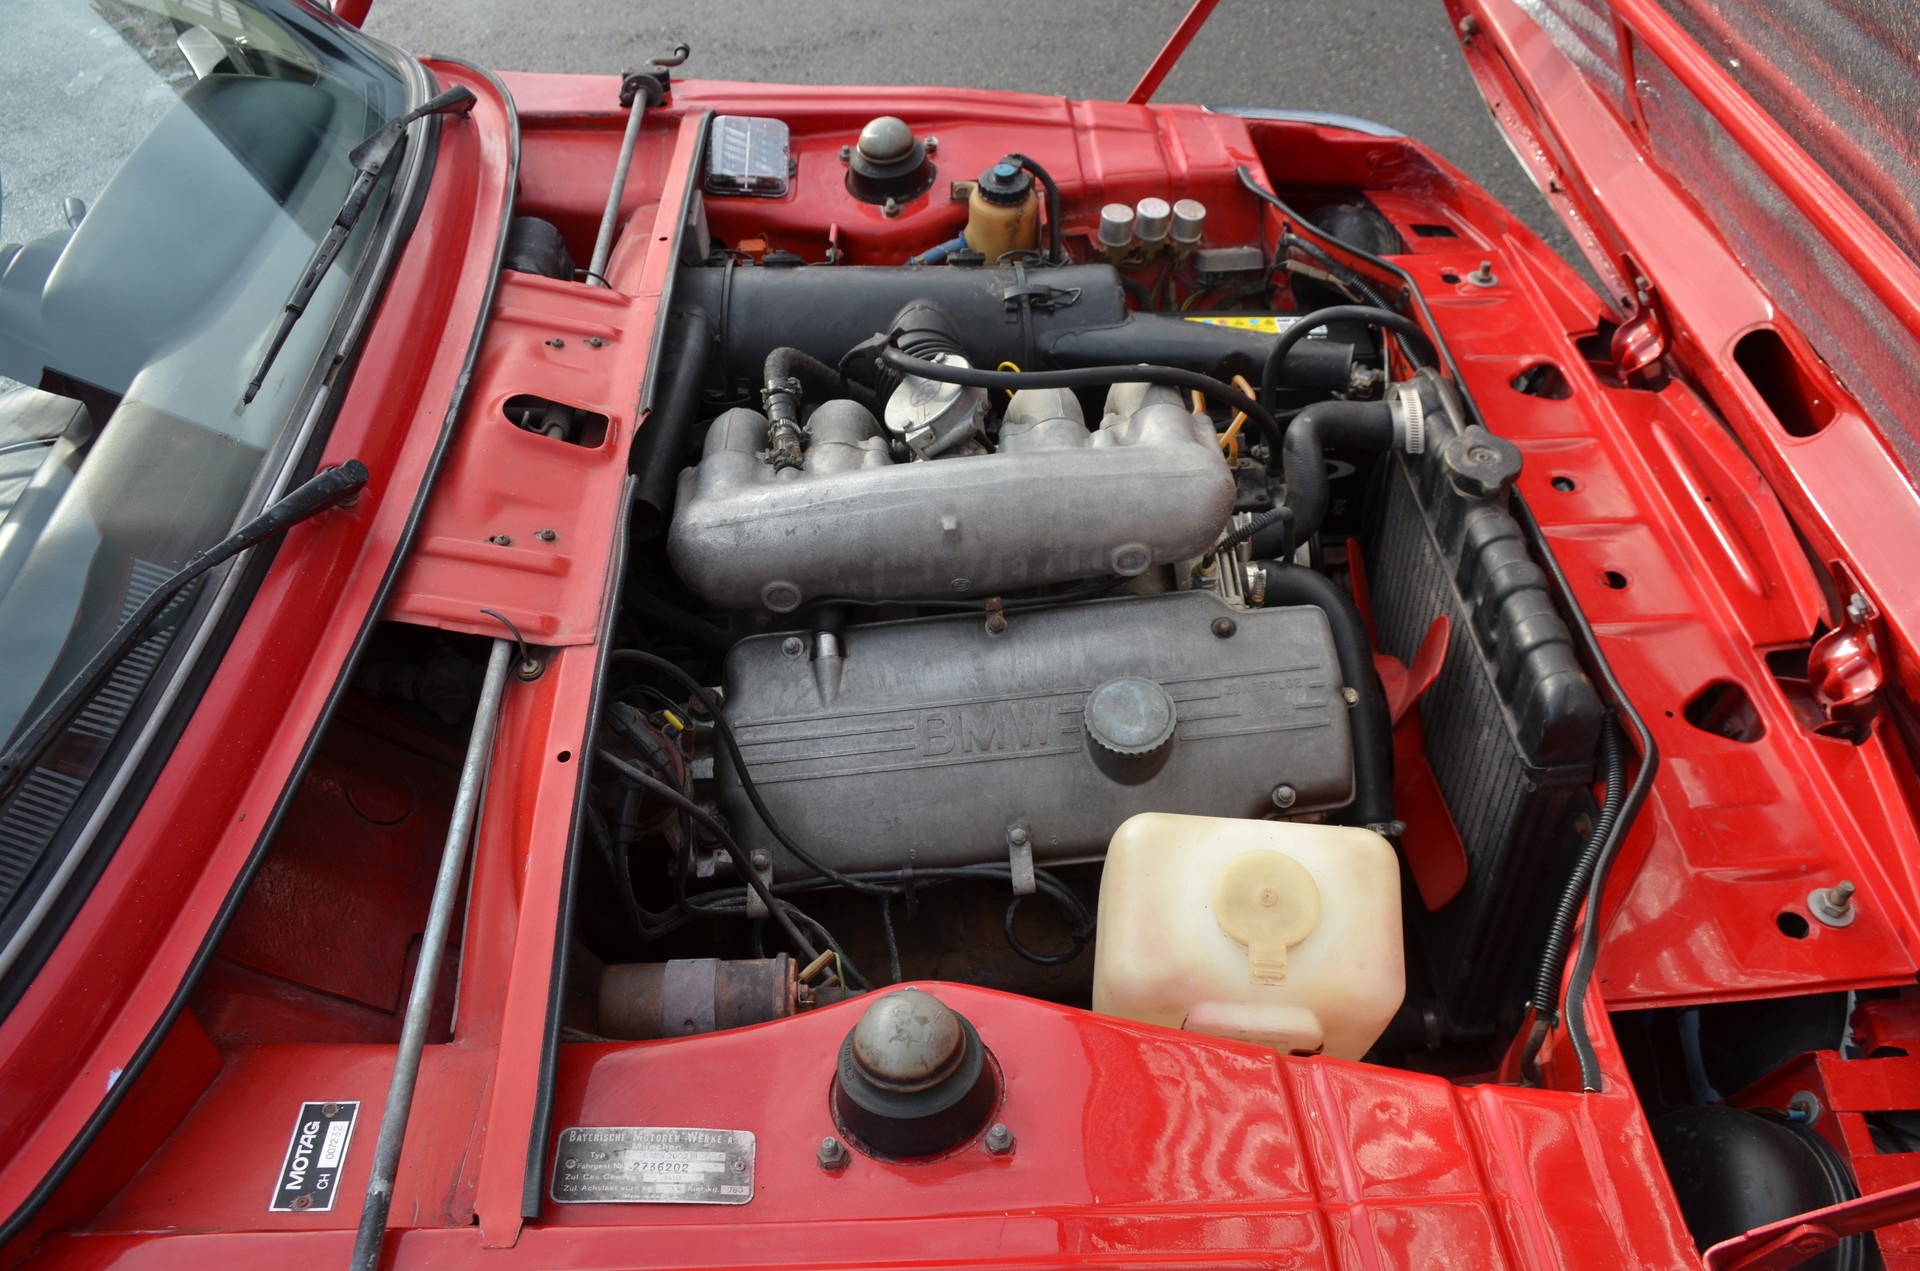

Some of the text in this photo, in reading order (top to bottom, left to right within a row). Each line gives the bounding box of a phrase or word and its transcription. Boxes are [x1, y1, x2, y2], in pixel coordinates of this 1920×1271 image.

[921, 701, 1050, 757] BMW
[569, 1130, 626, 1142] BAYERISCHE
[285, 1121, 321, 1190] MOTAG
[590, 1151, 606, 1160] Typ
[633, 1161, 689, 1173] 2736202
[316, 1173, 331, 1190] CH
